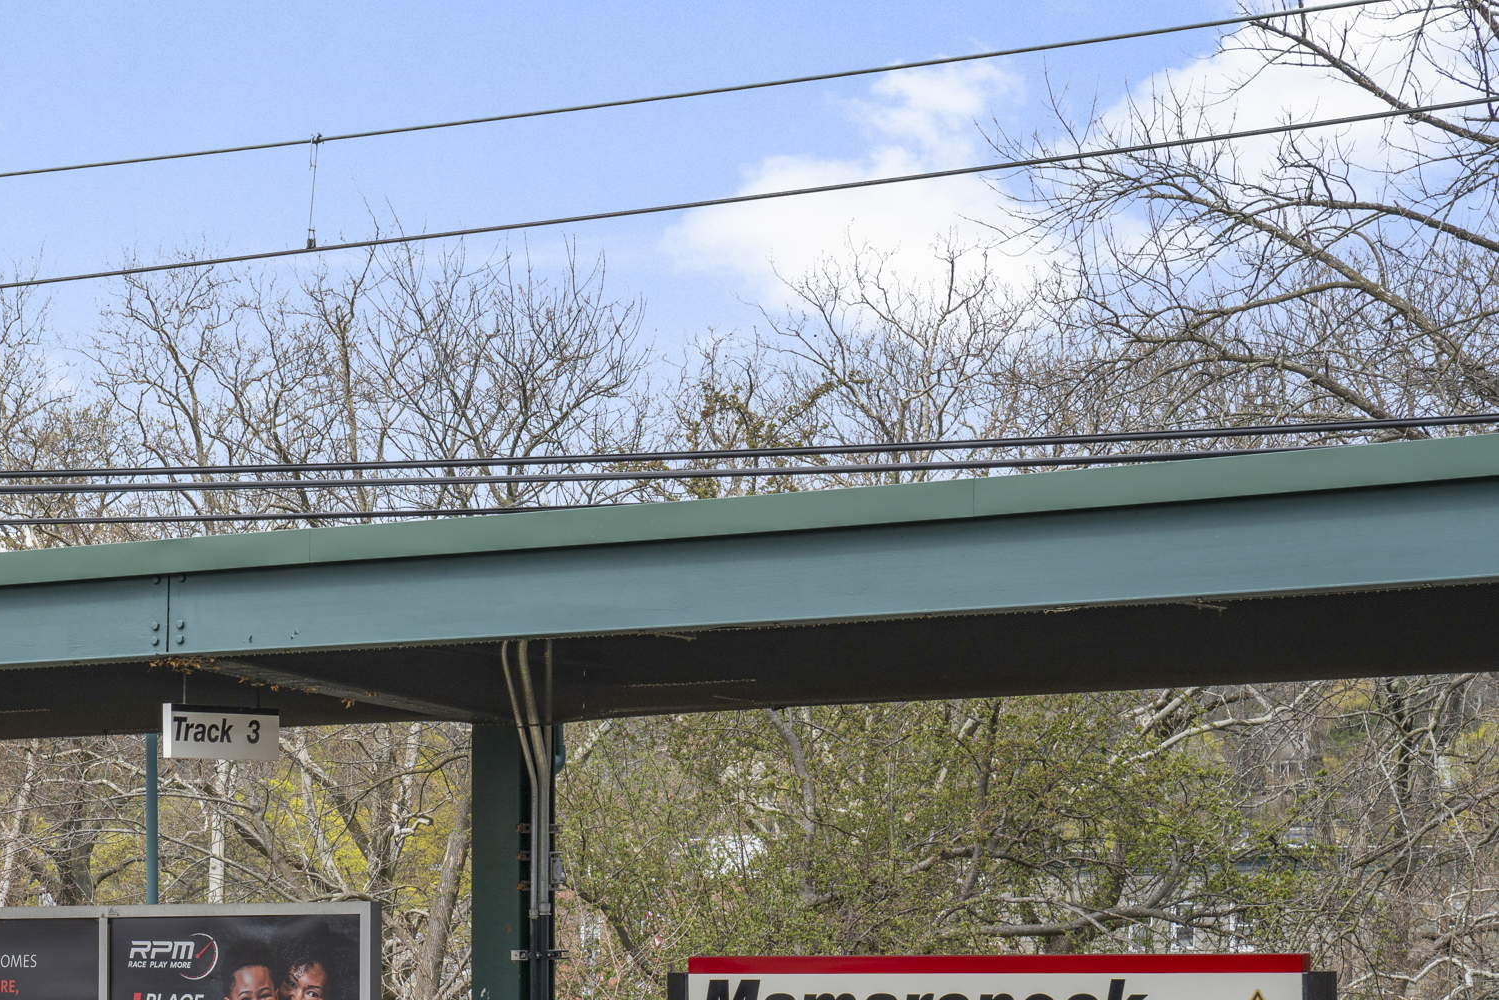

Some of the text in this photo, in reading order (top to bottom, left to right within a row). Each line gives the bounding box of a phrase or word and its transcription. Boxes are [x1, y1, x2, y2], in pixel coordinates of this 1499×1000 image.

[173, 716, 261, 744] Track 3
[129, 940, 195, 960] RPM
